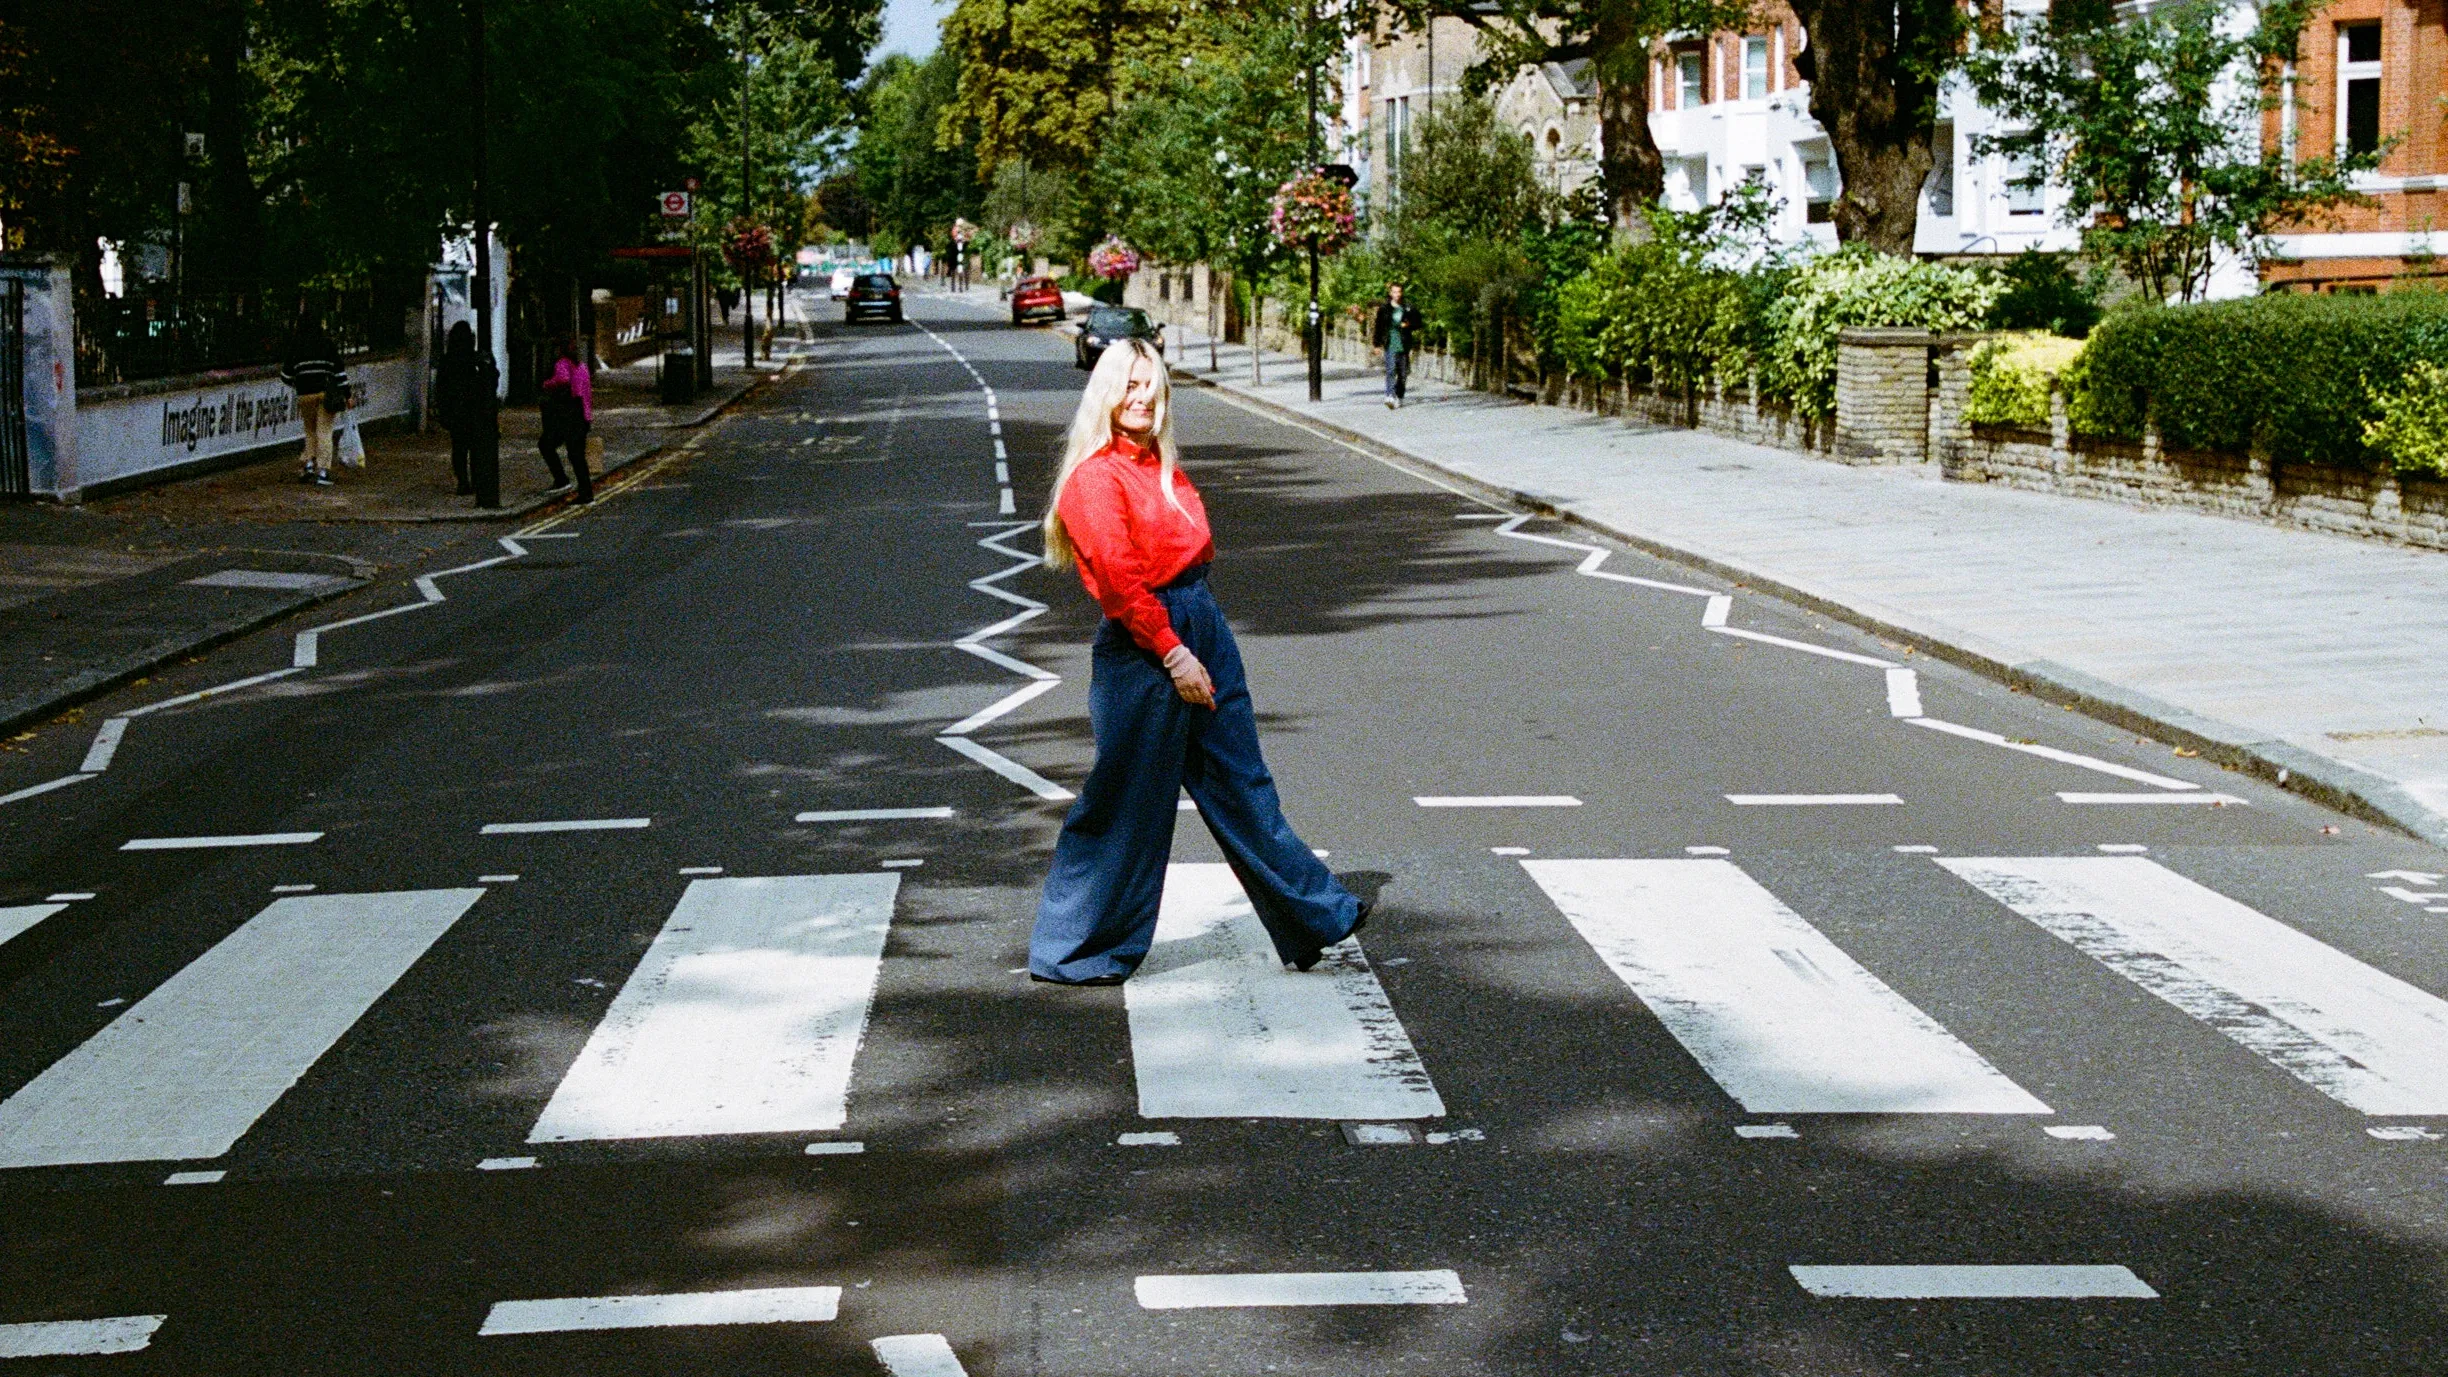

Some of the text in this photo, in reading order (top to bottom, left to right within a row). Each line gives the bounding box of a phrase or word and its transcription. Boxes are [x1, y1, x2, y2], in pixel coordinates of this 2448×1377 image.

[161, 396, 216, 451] Imagine
[219, 394, 235, 435] all
[236, 391, 254, 433] the
[255, 387, 289, 438] people
